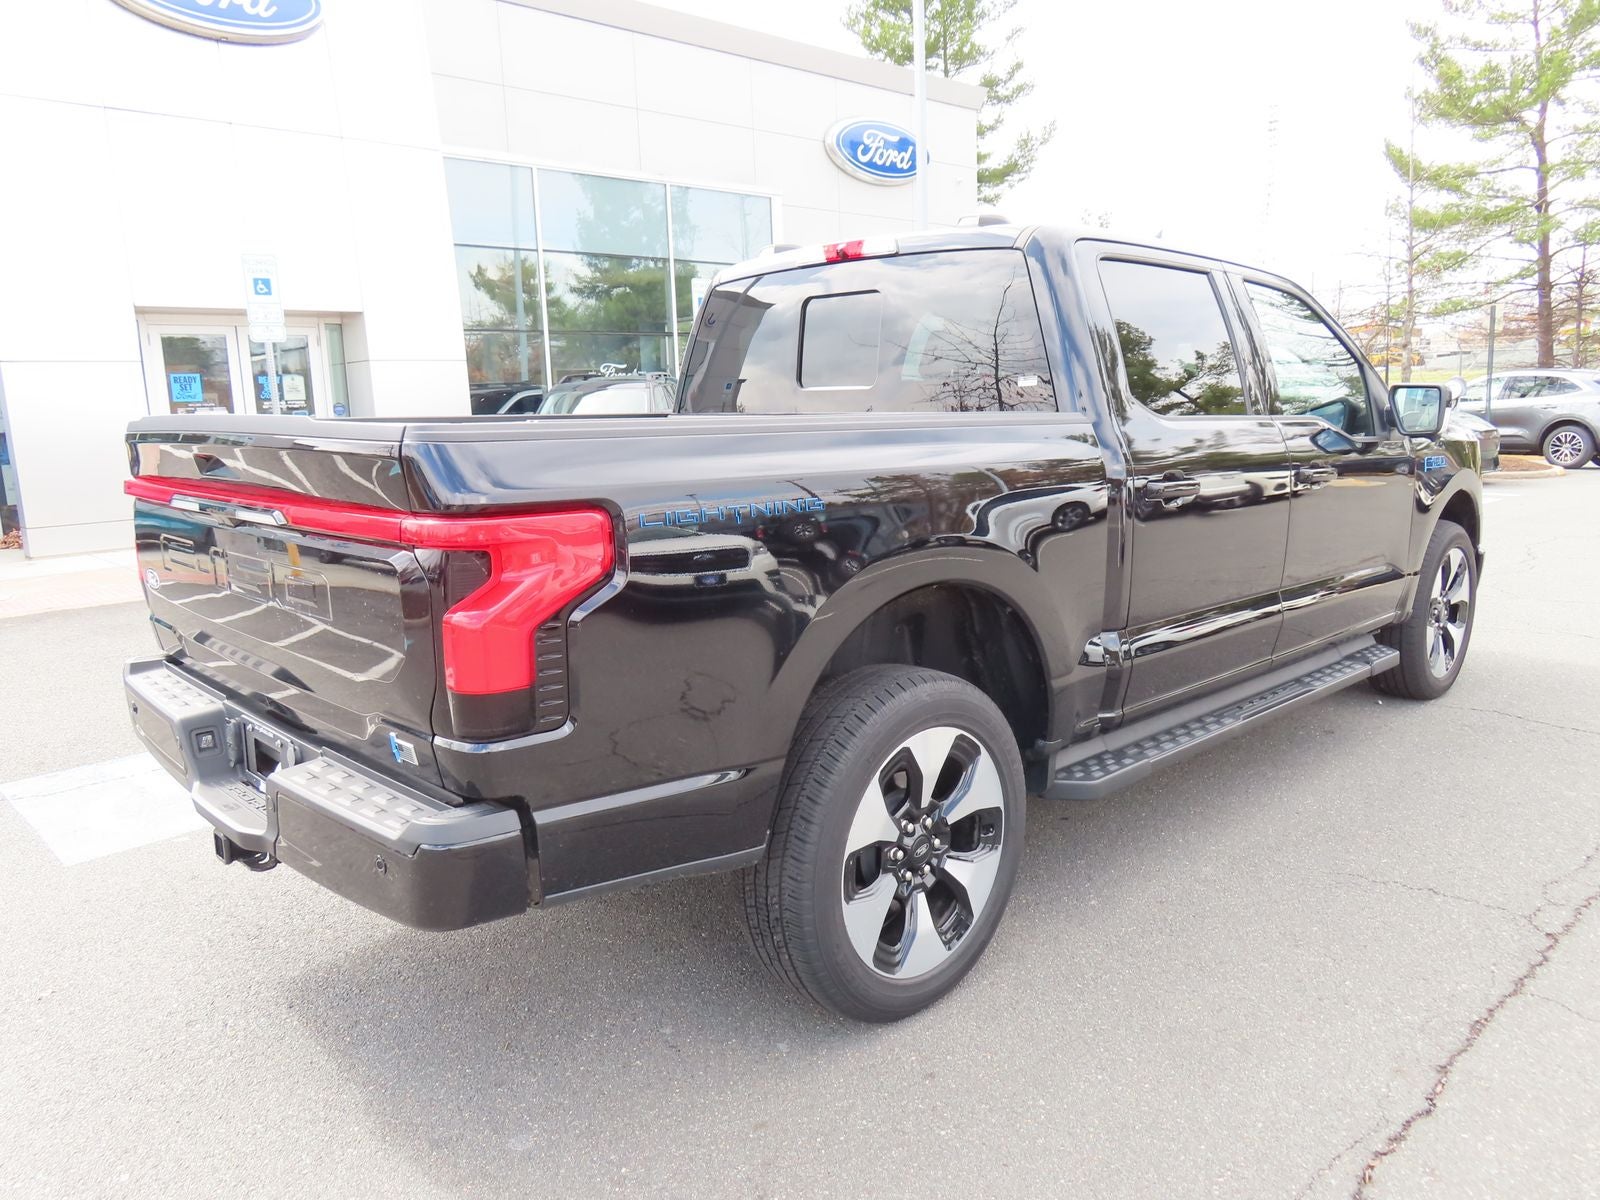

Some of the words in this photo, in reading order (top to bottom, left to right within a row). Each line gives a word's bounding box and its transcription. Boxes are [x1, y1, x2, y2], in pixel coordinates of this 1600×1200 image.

[857, 129, 914, 170] Ford
[172, 376, 197, 384] READY
[179, 383, 193, 391] SET
[639, 497, 825, 528] LIGHTNING
